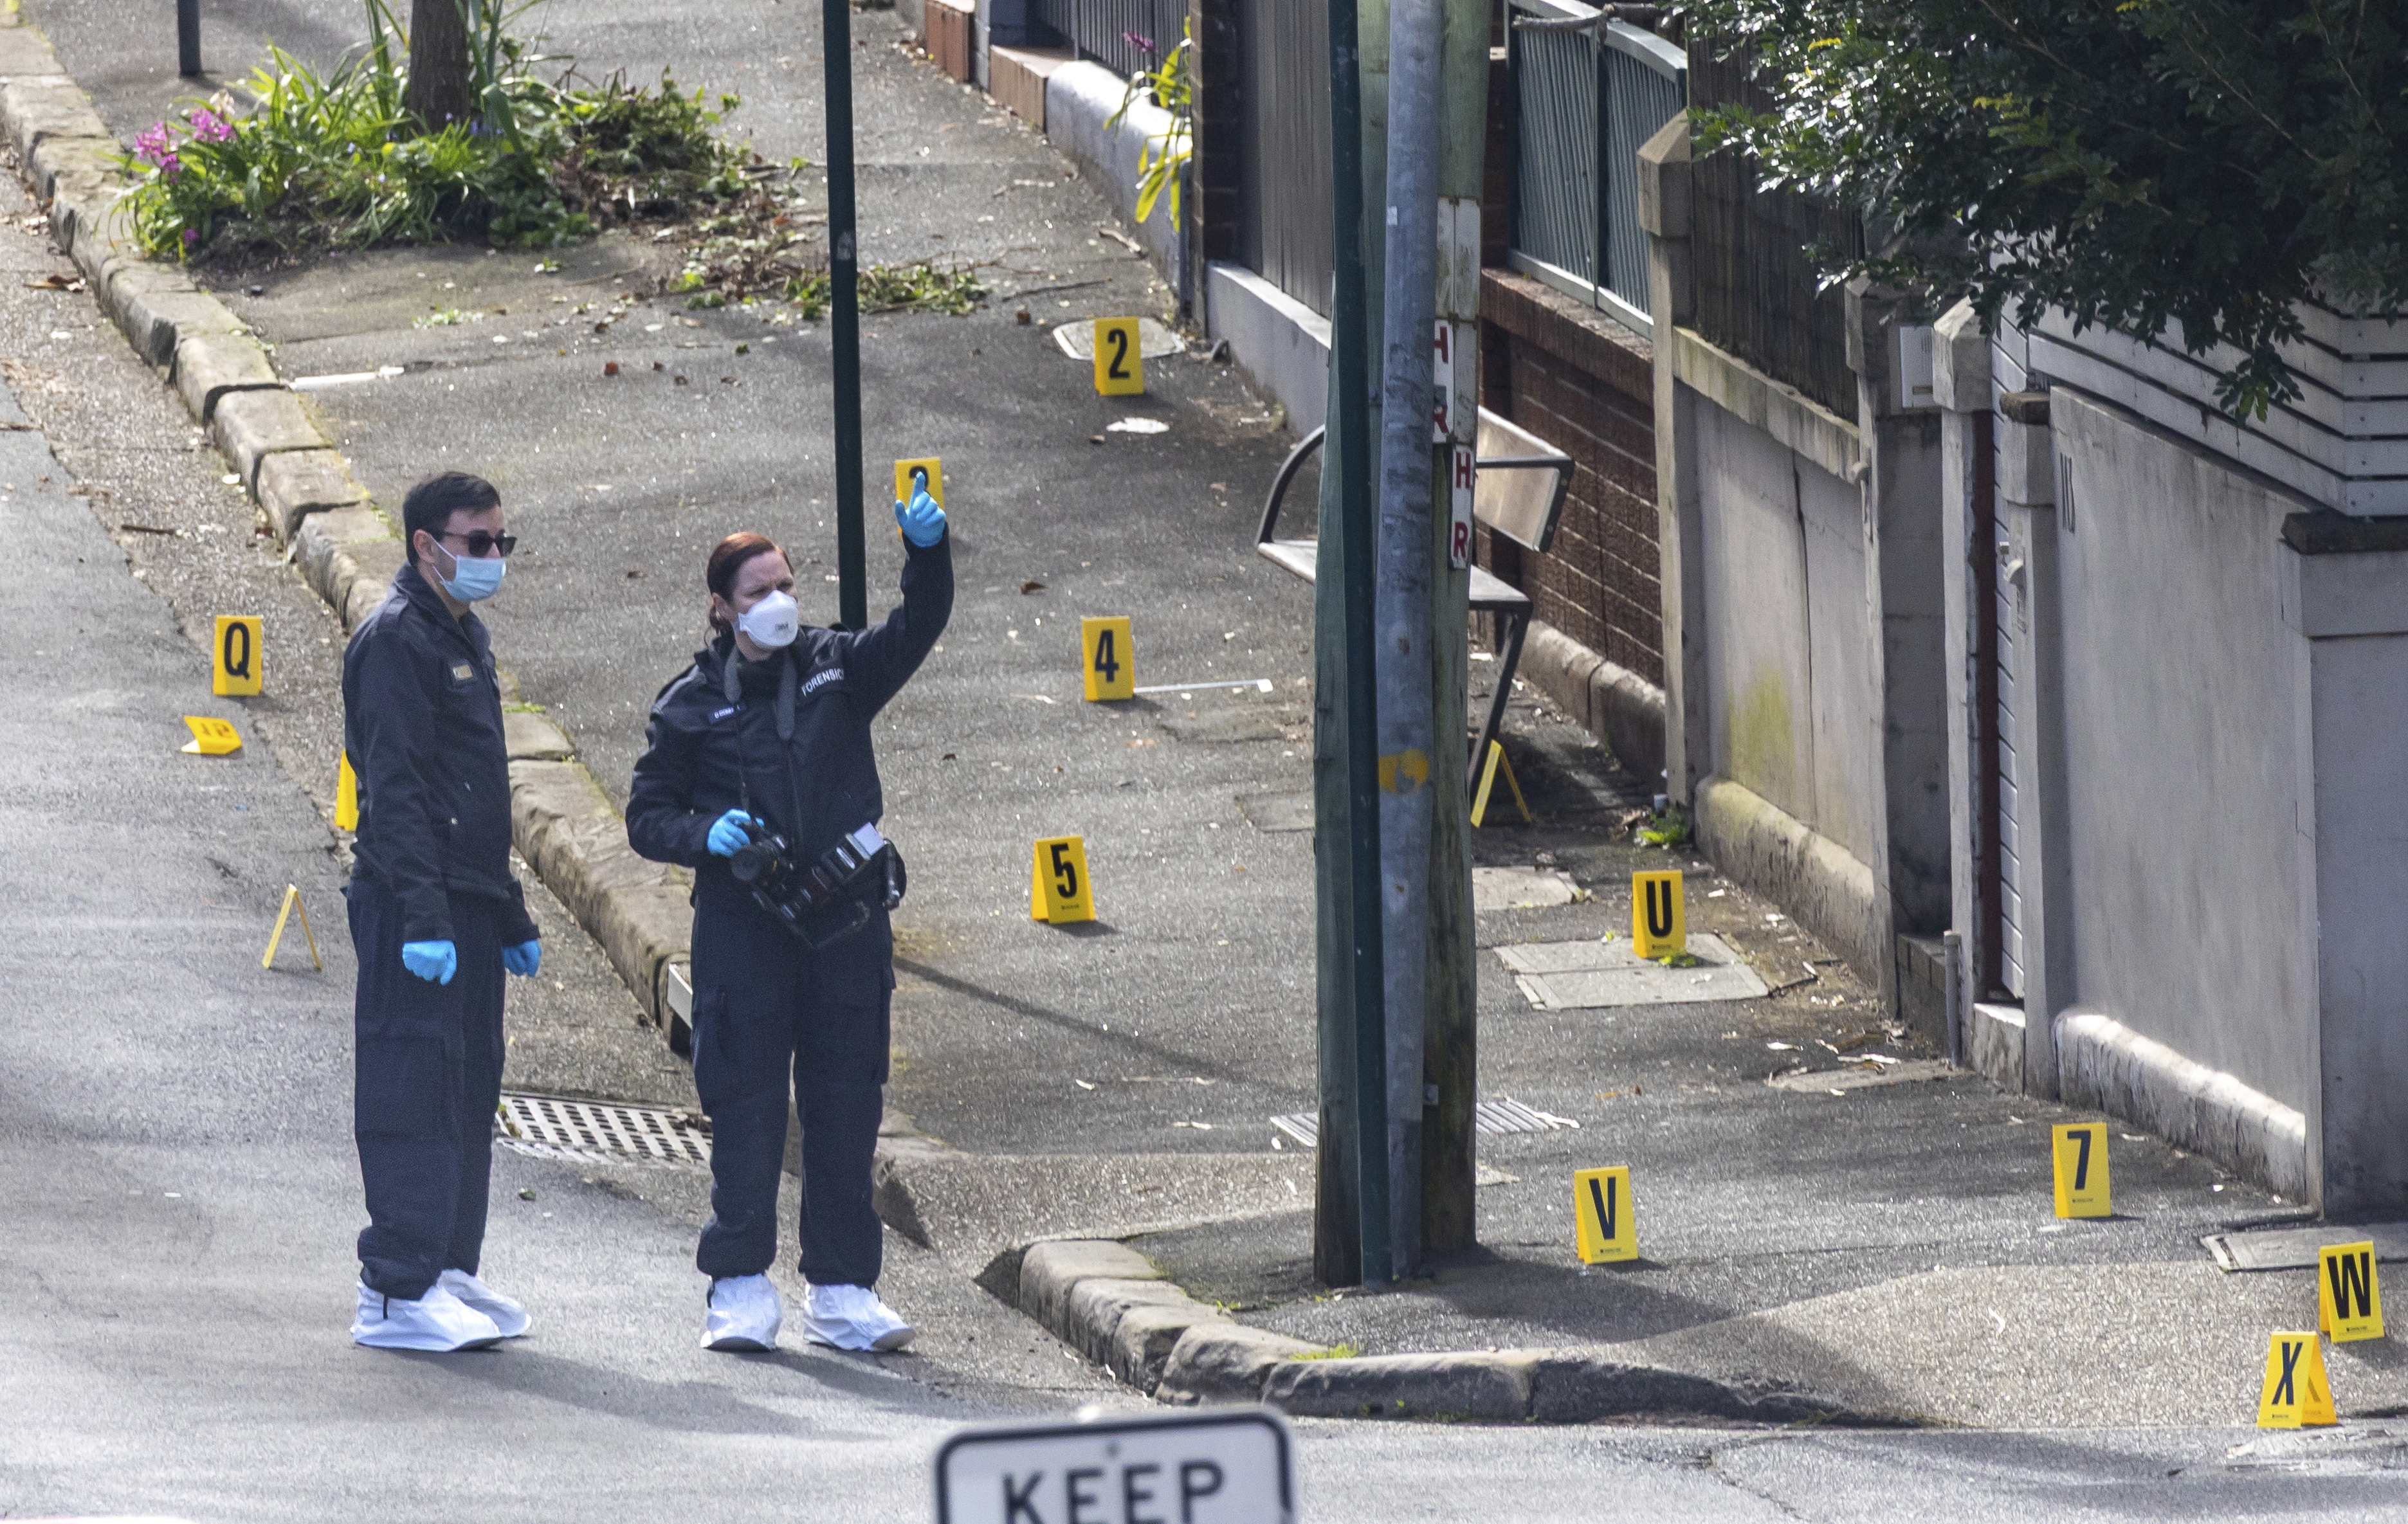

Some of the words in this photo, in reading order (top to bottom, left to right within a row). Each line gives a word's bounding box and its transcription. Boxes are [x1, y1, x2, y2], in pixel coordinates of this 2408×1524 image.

[1108, 328, 1131, 381] 2
[224, 622, 251, 680] Q
[1095, 629, 1119, 683] 4
[1050, 842, 1077, 898] 5
[1645, 880, 1674, 938] U
[2066, 1130, 2092, 1190] 7
[1588, 1176, 1618, 1241] V
[2326, 1251, 2372, 1320] W
[2276, 1341, 2304, 1406] X
[1003, 1461, 1224, 1524] KEEP
